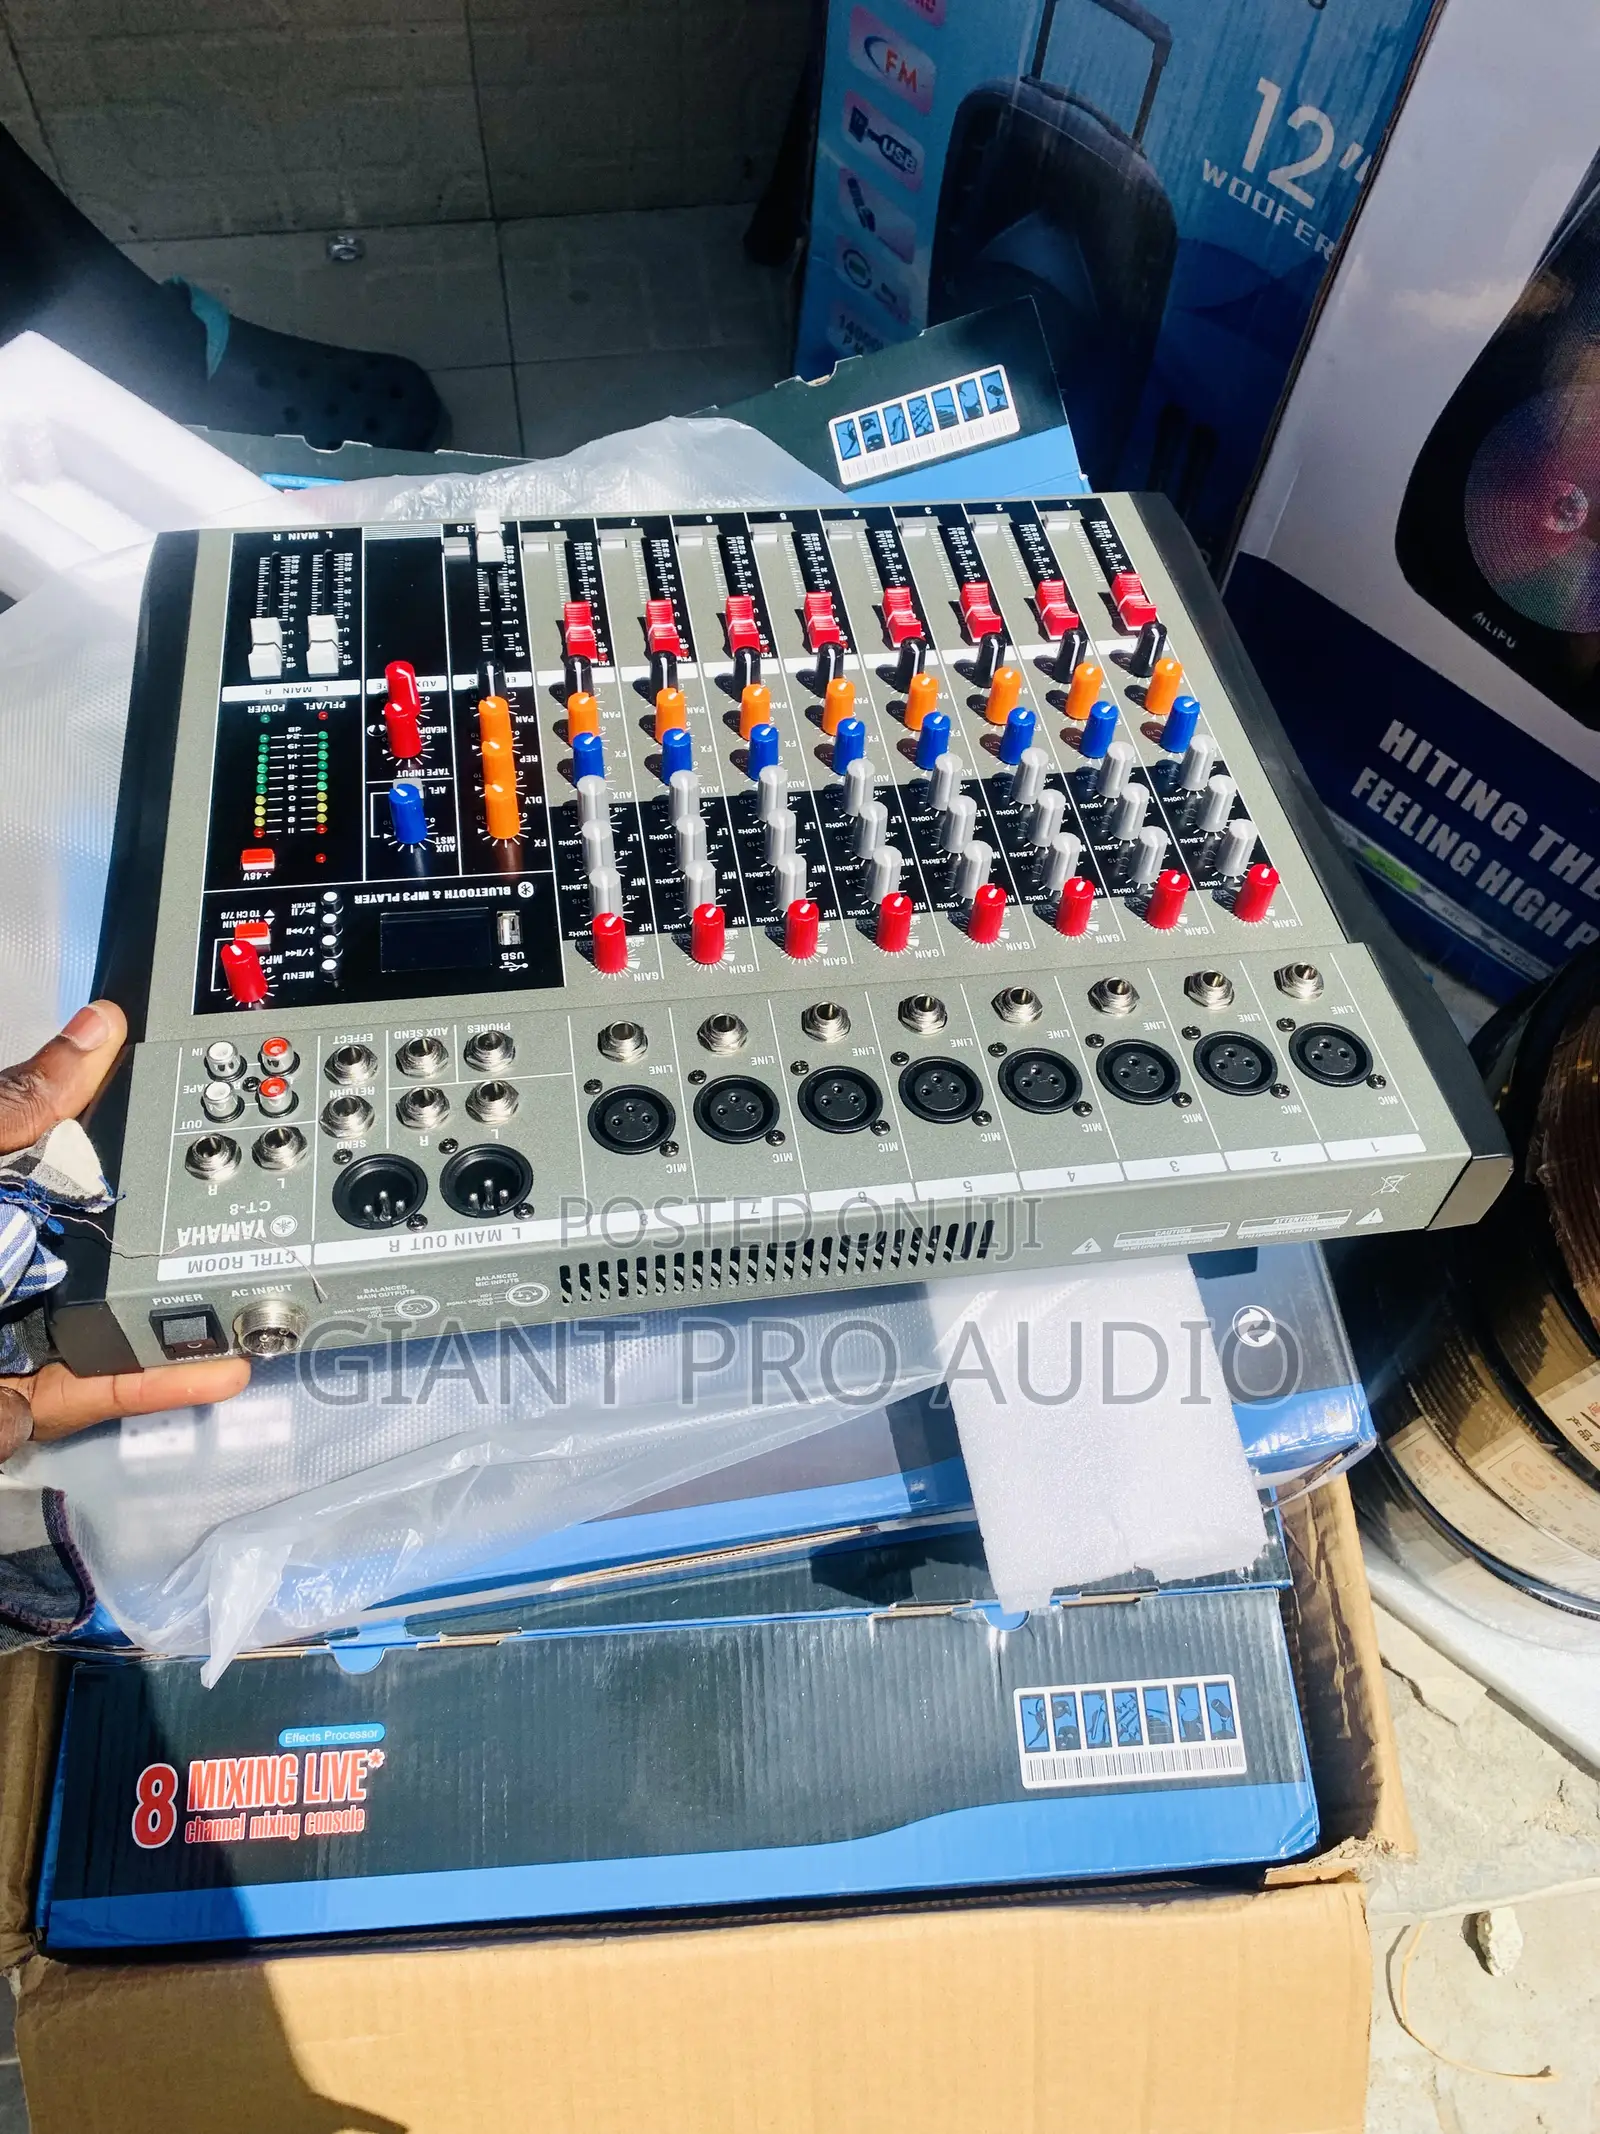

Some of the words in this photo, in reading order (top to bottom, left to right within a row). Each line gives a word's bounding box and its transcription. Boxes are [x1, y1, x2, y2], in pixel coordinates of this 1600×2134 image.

[886, 49, 917, 93] FM
[881, 137, 918, 174] USB
[1203, 158, 1336, 261] WOOFER
[996, 504, 1003, 512] 2
[705, 515, 712, 523] 6
[780, 512, 787, 520] 5
[630, 518, 637, 526] 7
[272, 533, 281, 541] R
[288, 532, 318, 540] MAIN
[1472, 612, 1516, 648] AILIPU
[248, 704, 285, 713] POWER
[303, 701, 346, 710] PFL/AFL
[686, 706, 705, 714] PAN
[515, 715, 534, 723] PAN
[602, 711, 620, 719] PAN
[614, 750, 627, 758] FX
[396, 769, 424, 777] INPUT
[427, 768, 449, 776] TAPE
[1379, 719, 1528, 842] HITING
[429, 786, 446, 794] AFL
[700, 785, 719, 794] AUX
[525, 796, 542, 804] DLY
[612, 791, 632, 799] AUX
[717, 828, 728, 836] LF
[435, 836, 455, 844] MST
[534, 839, 547, 847] FX
[436, 844, 456, 852] AUX
[1351, 767, 1481, 877] FEELING
[1476, 860, 1573, 937] HIGH
[243, 872, 271, 880] +48V
[722, 871, 737, 879] MF
[631, 878, 646, 886] MF
[402, 890, 430, 901] MP3
[432, 890, 440, 898] &
[444, 886, 511, 899] BLUETOOTH
[354, 892, 400, 904] PLAYER
[732, 916, 746, 924] HF
[1273, 919, 1297, 928] GAIN
[639, 923, 652, 931] HF
[1184, 926, 1208, 935] GAIN
[1096, 934, 1120, 943] GAIN
[1005, 941, 1030, 951] GAIN
[501, 952, 524, 960] USB
[915, 949, 939, 958] GAIN
[259, 955, 283, 964] MP3
[822, 957, 847, 966] GAIN
[729, 965, 754, 974] GAIN
[282, 971, 314, 980] MENU
[633, 971, 658, 981] GAIN
[1330, 1004, 1354, 1016] LINE
[1237, 1012, 1260, 1023] LINE
[467, 1022, 511, 1033] PHONES
[1143, 1020, 1166, 1031] LINE
[394, 1029, 423, 1039] SEND
[425, 1026, 448, 1036] AUX
[1046, 1028, 1070, 1039] LINE
[333, 1033, 373, 1045] EFFECT
[950, 1037, 973, 1048] LINE
[192, 1048, 203, 1056] IN
[852, 1046, 875, 1056] LINE
[750, 1055, 774, 1066] LINE
[648, 1064, 673, 1075] LINE
[183, 1084, 208, 1094] APE
[329, 1086, 375, 1098] RETURN
[1377, 1095, 1399, 1106] MIC
[1280, 1104, 1301, 1115] MIC
[1181, 1113, 1203, 1124] MIC
[180, 1120, 202, 1129] OUT
[1081, 1121, 1102, 1133] MIC
[491, 1129, 499, 1139] L
[980, 1131, 1001, 1143] MIC
[337, 1139, 367, 1149] SEND
[420, 1136, 429, 1146] R
[877, 1142, 898, 1153] MIC
[1370, 1142, 1380, 1153] 1
[772, 1152, 793, 1163] MIC
[1270, 1151, 1281, 1163] 2
[665, 1162, 687, 1173] MIC
[1169, 1160, 1180, 1173] 3
[1067, 1171, 1076, 1183] 4
[208, 1185, 218, 1196] R
[963, 1180, 973, 1192] 5
[858, 1191, 867, 1202] 6
[229, 1201, 271, 1216] CT-8
[750, 1202, 759, 1214] 7
[177, 1219, 266, 1246] YAMAHA
[454, 1229, 502, 1246] MAIN
[512, 1227, 520, 1240] L
[388, 1240, 400, 1253] R
[410, 1234, 447, 1250] OUT
[250, 1250, 297, 1268] CTRL
[187, 1260, 242, 1274] ROOM
[476, 1272, 518, 1282] BALANCED
[231, 1288, 249, 1298] AC
[251, 1284, 292, 1295] INPUT
[363, 1284, 408, 1293] BALANCED
[379, 1289, 416, 1298] OUTPUTS
[152, 1293, 203, 1306] POWER
[285, 1732, 321, 1743] Effects
[324, 1730, 379, 1742] Processor
[187, 1754, 299, 1812] MIXING
[132, 1763, 179, 1849] 8
[185, 1812, 246, 1844] channel
[250, 1810, 300, 1840] mixing
[304, 1805, 365, 1835] console
